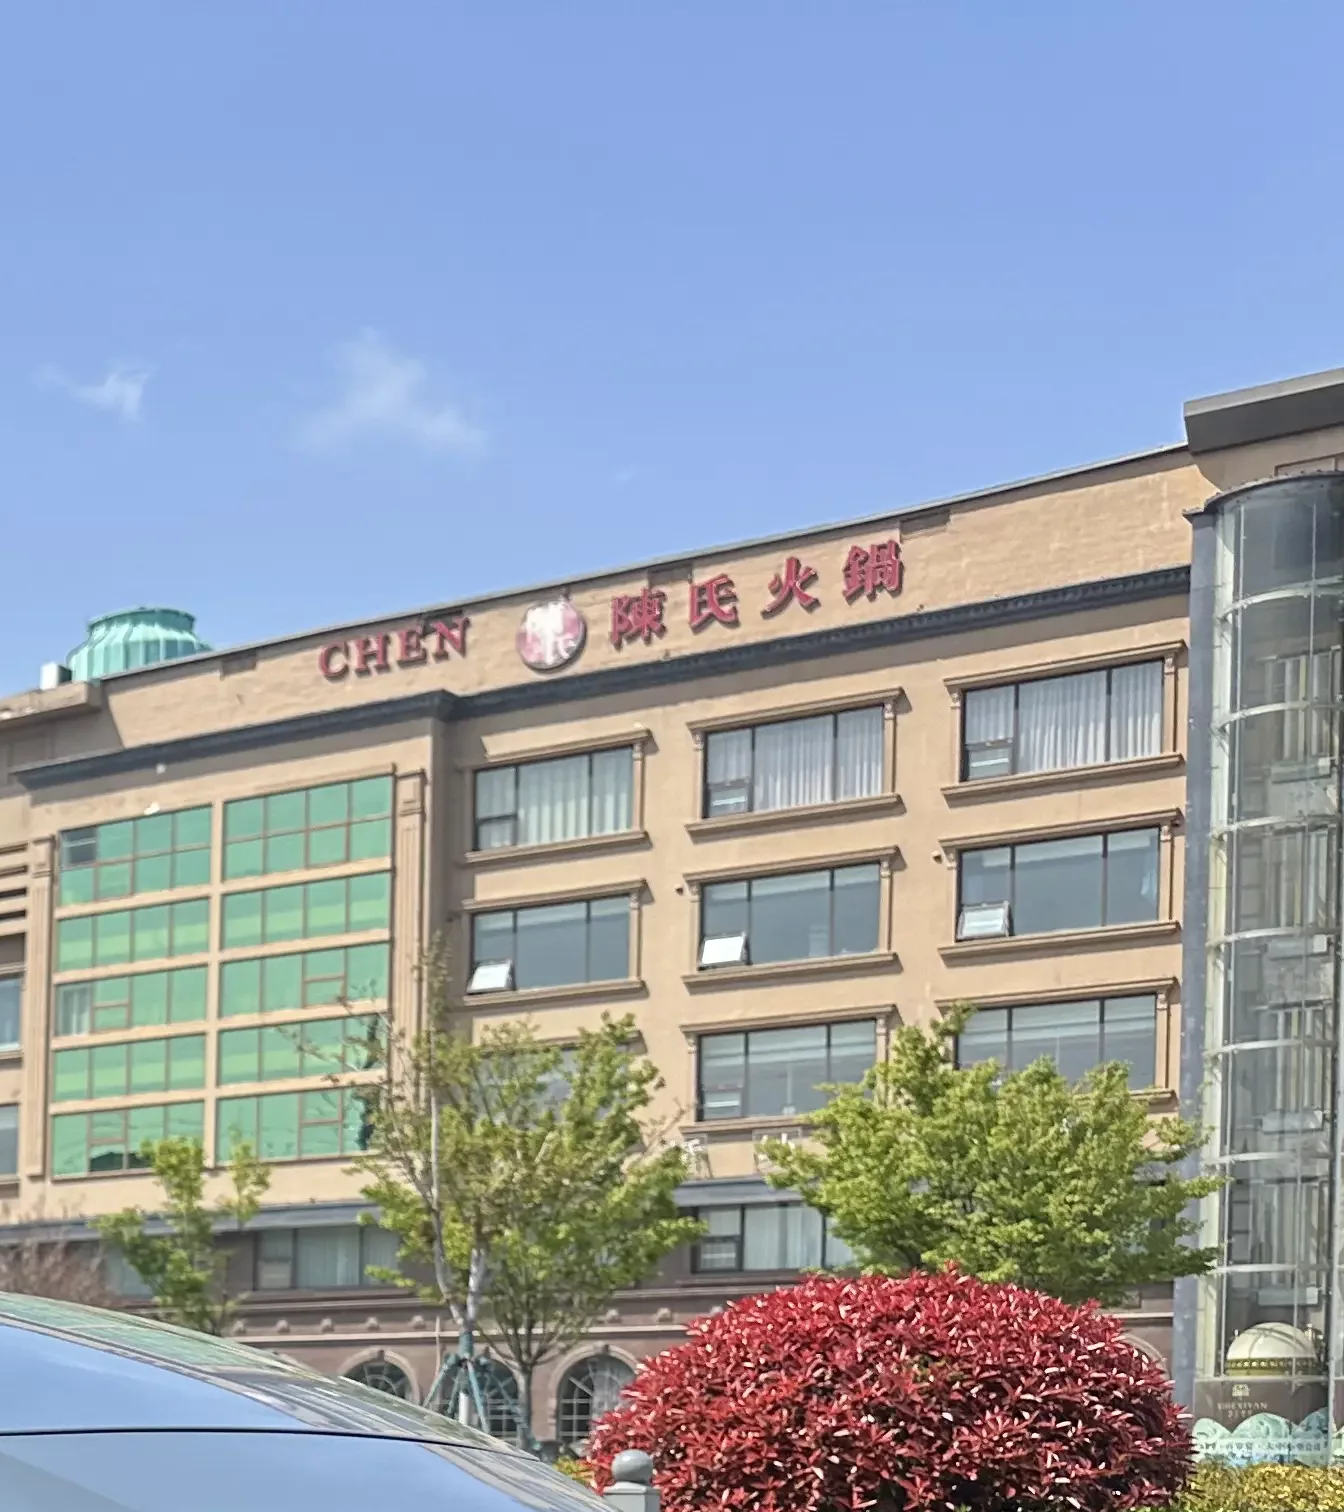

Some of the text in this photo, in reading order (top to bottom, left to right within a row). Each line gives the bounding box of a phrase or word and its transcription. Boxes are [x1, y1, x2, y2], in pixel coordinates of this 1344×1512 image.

[611, 539, 903, 648] 陳氏火鍋
[318, 617, 470, 679] CHEN
